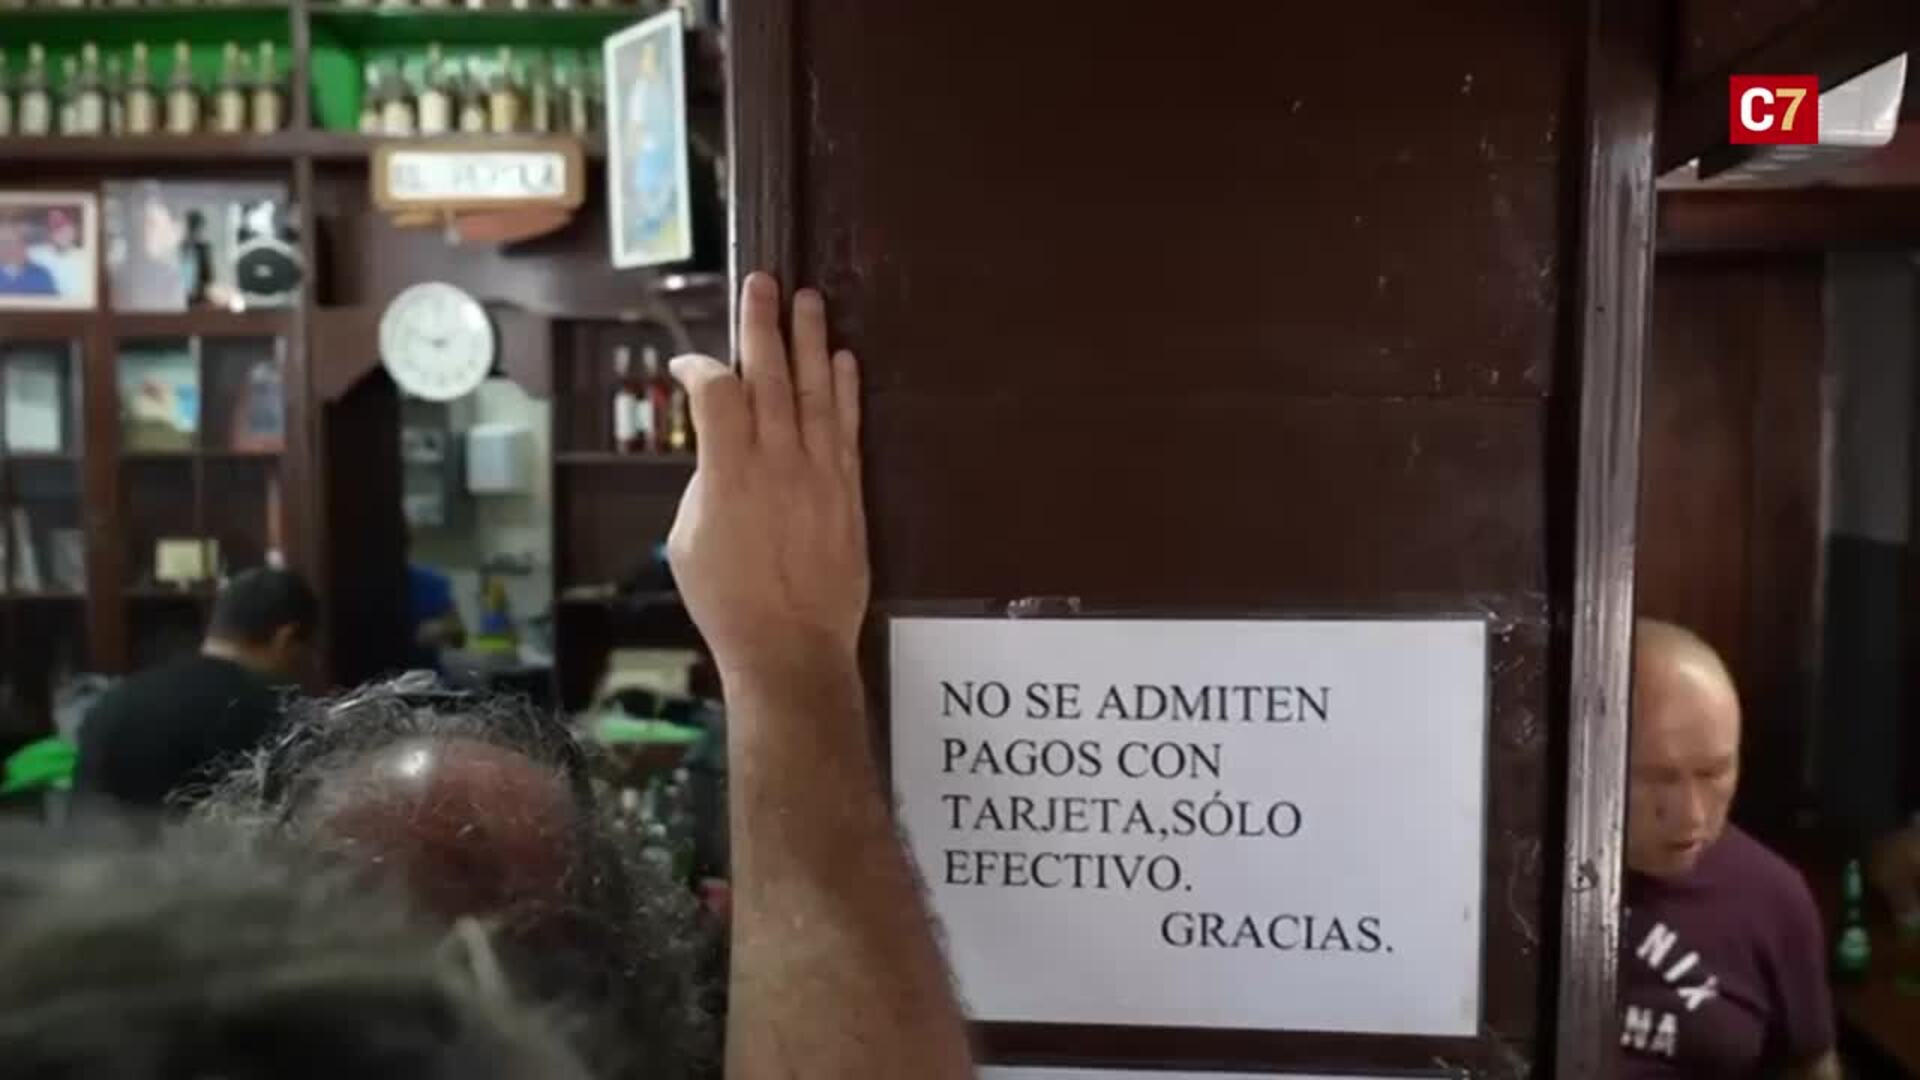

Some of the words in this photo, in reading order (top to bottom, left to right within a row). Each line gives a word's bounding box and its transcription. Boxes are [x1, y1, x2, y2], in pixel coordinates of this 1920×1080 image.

[940, 680, 1011, 719] NO
[1025, 682, 1081, 719] SE
[1097, 684, 1331, 722] ADMITEN
[941, 738, 1103, 777] PAGOS
[1117, 741, 1221, 779] CON
[942, 849, 1192, 892] EFECTIVO.
[1160, 911, 1393, 953] GRACIAS.
